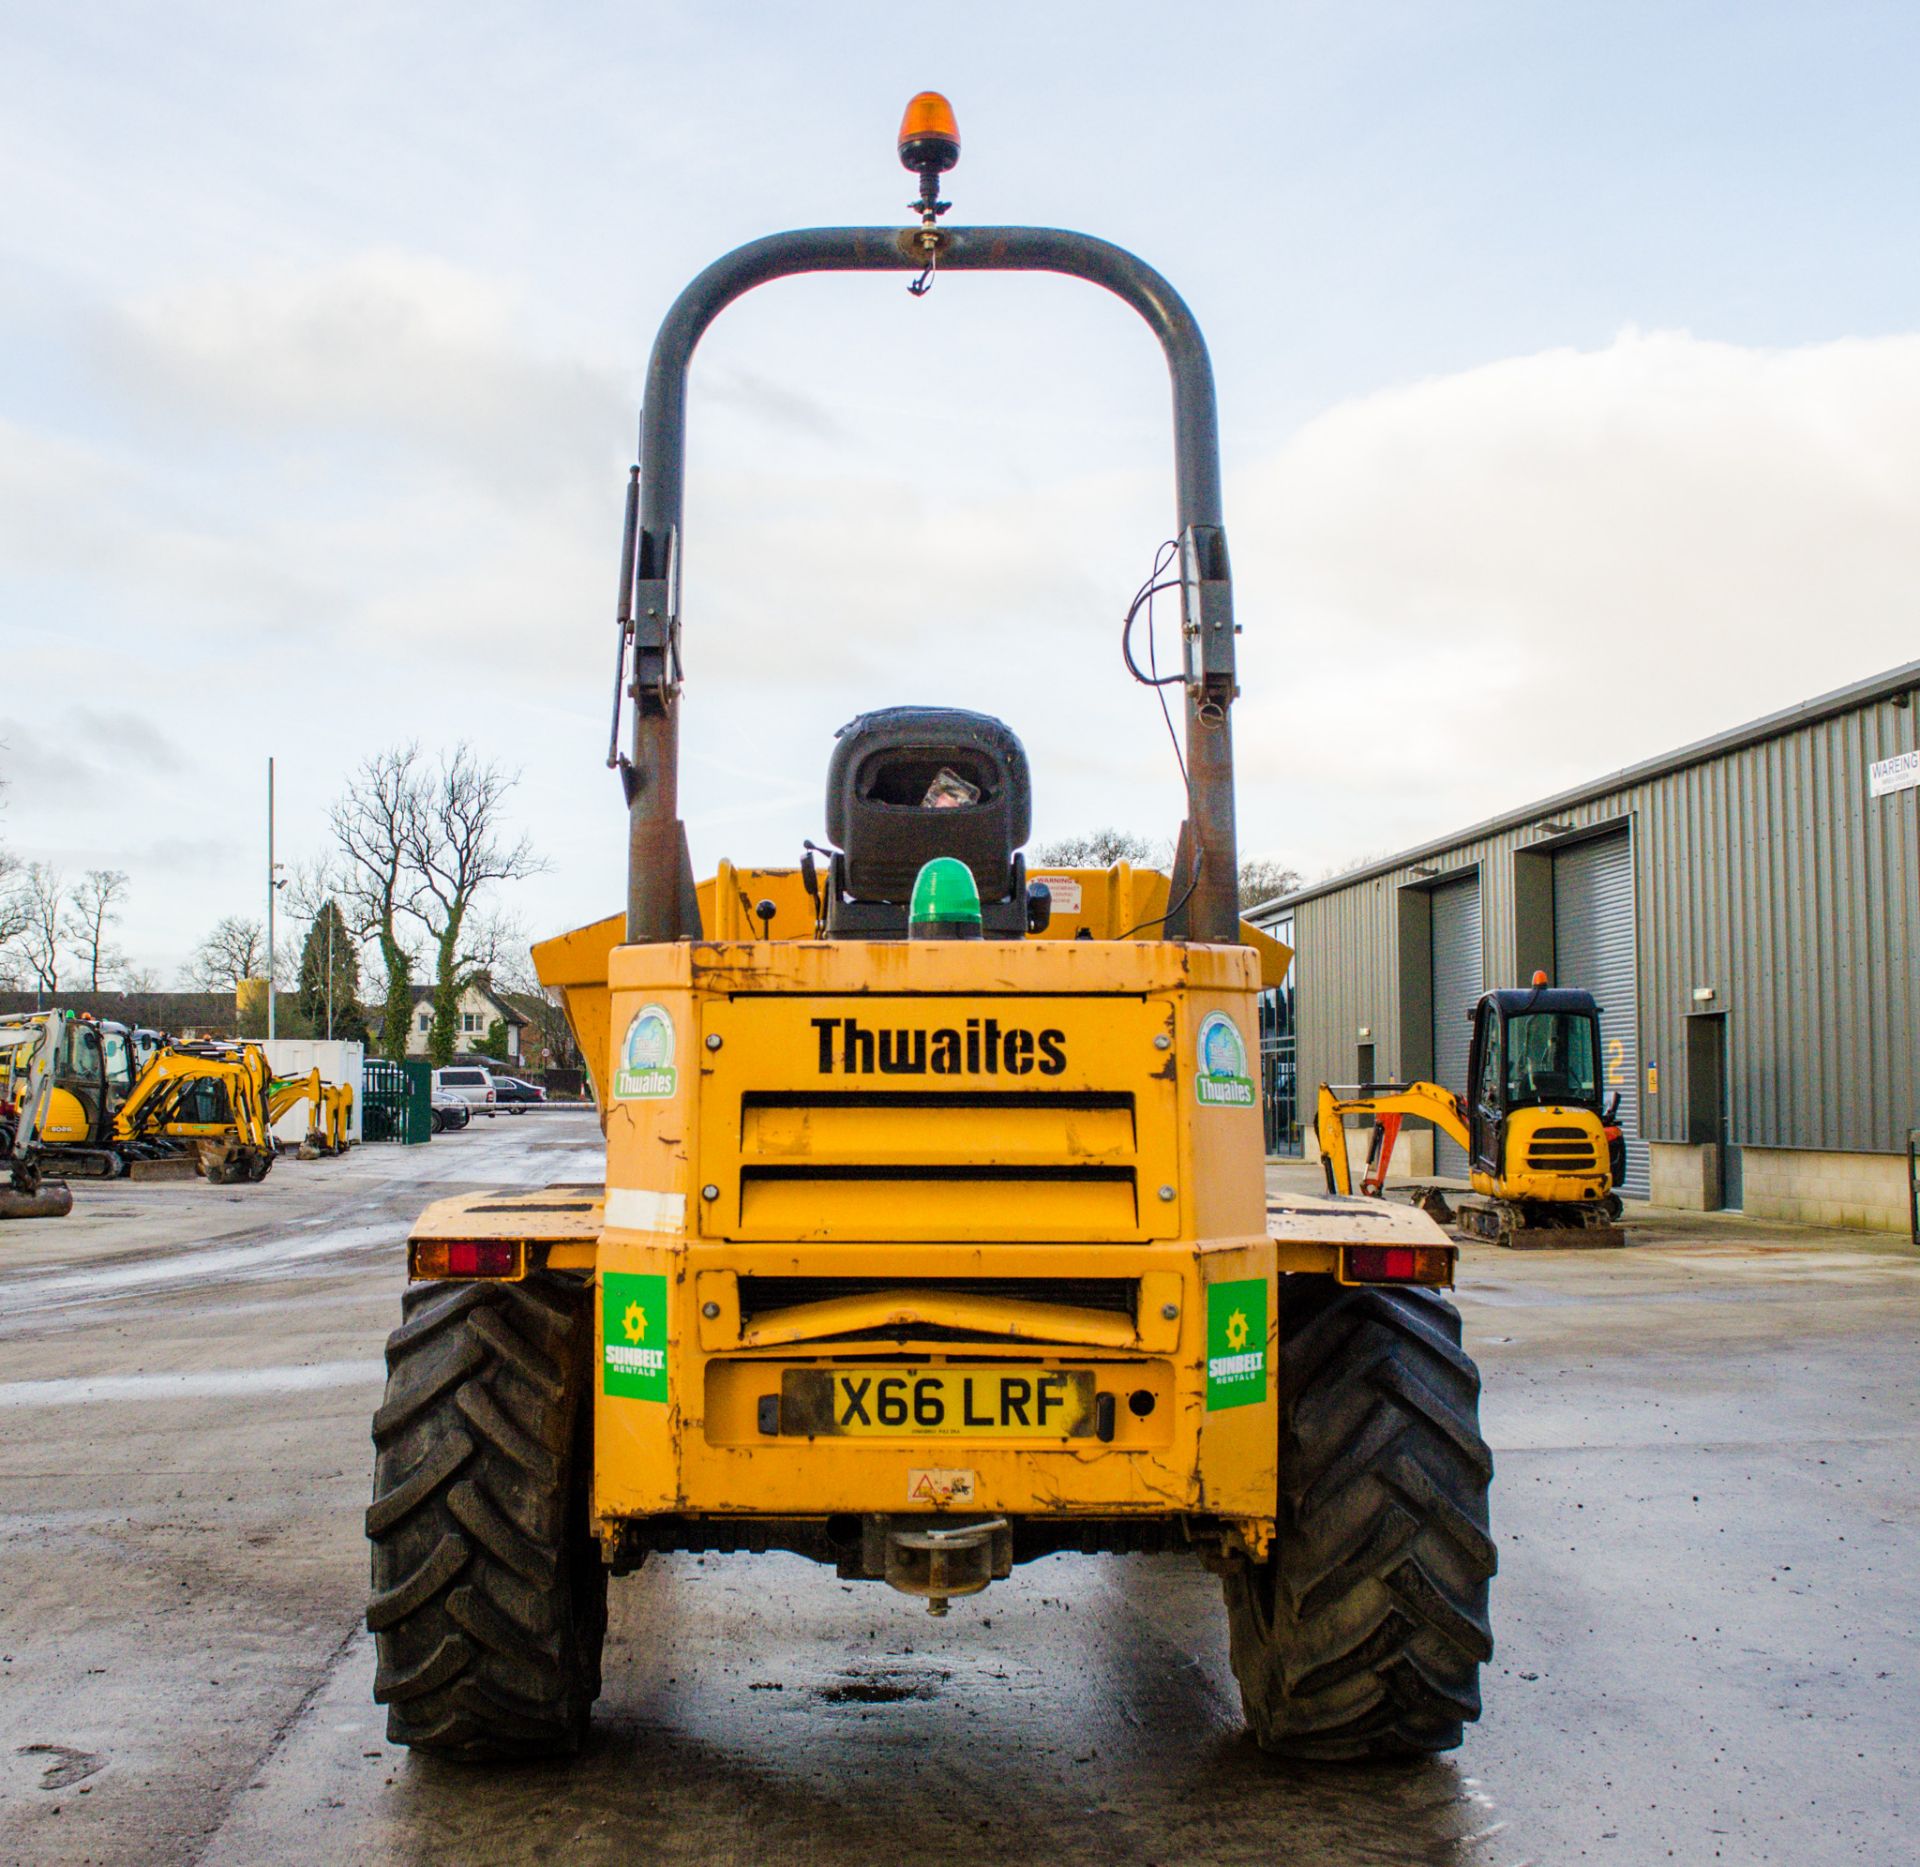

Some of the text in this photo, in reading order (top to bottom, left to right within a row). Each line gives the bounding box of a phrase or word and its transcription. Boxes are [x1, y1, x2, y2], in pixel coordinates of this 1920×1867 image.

[1872, 752, 1918, 779] WAREING
[811, 1018, 1067, 1076] Thwaites
[1608, 1040, 1624, 1084] 2
[619, 1072, 672, 1095] Thwaites
[1201, 1078, 1252, 1102] Thwaites
[605, 1345, 664, 1369] SUNBELT
[1209, 1352, 1263, 1378] SUNBELT
[613, 1365, 656, 1377] RENTALS
[1216, 1372, 1256, 1385] RENTALS
[841, 1378, 1067, 1426] X66 LRF
